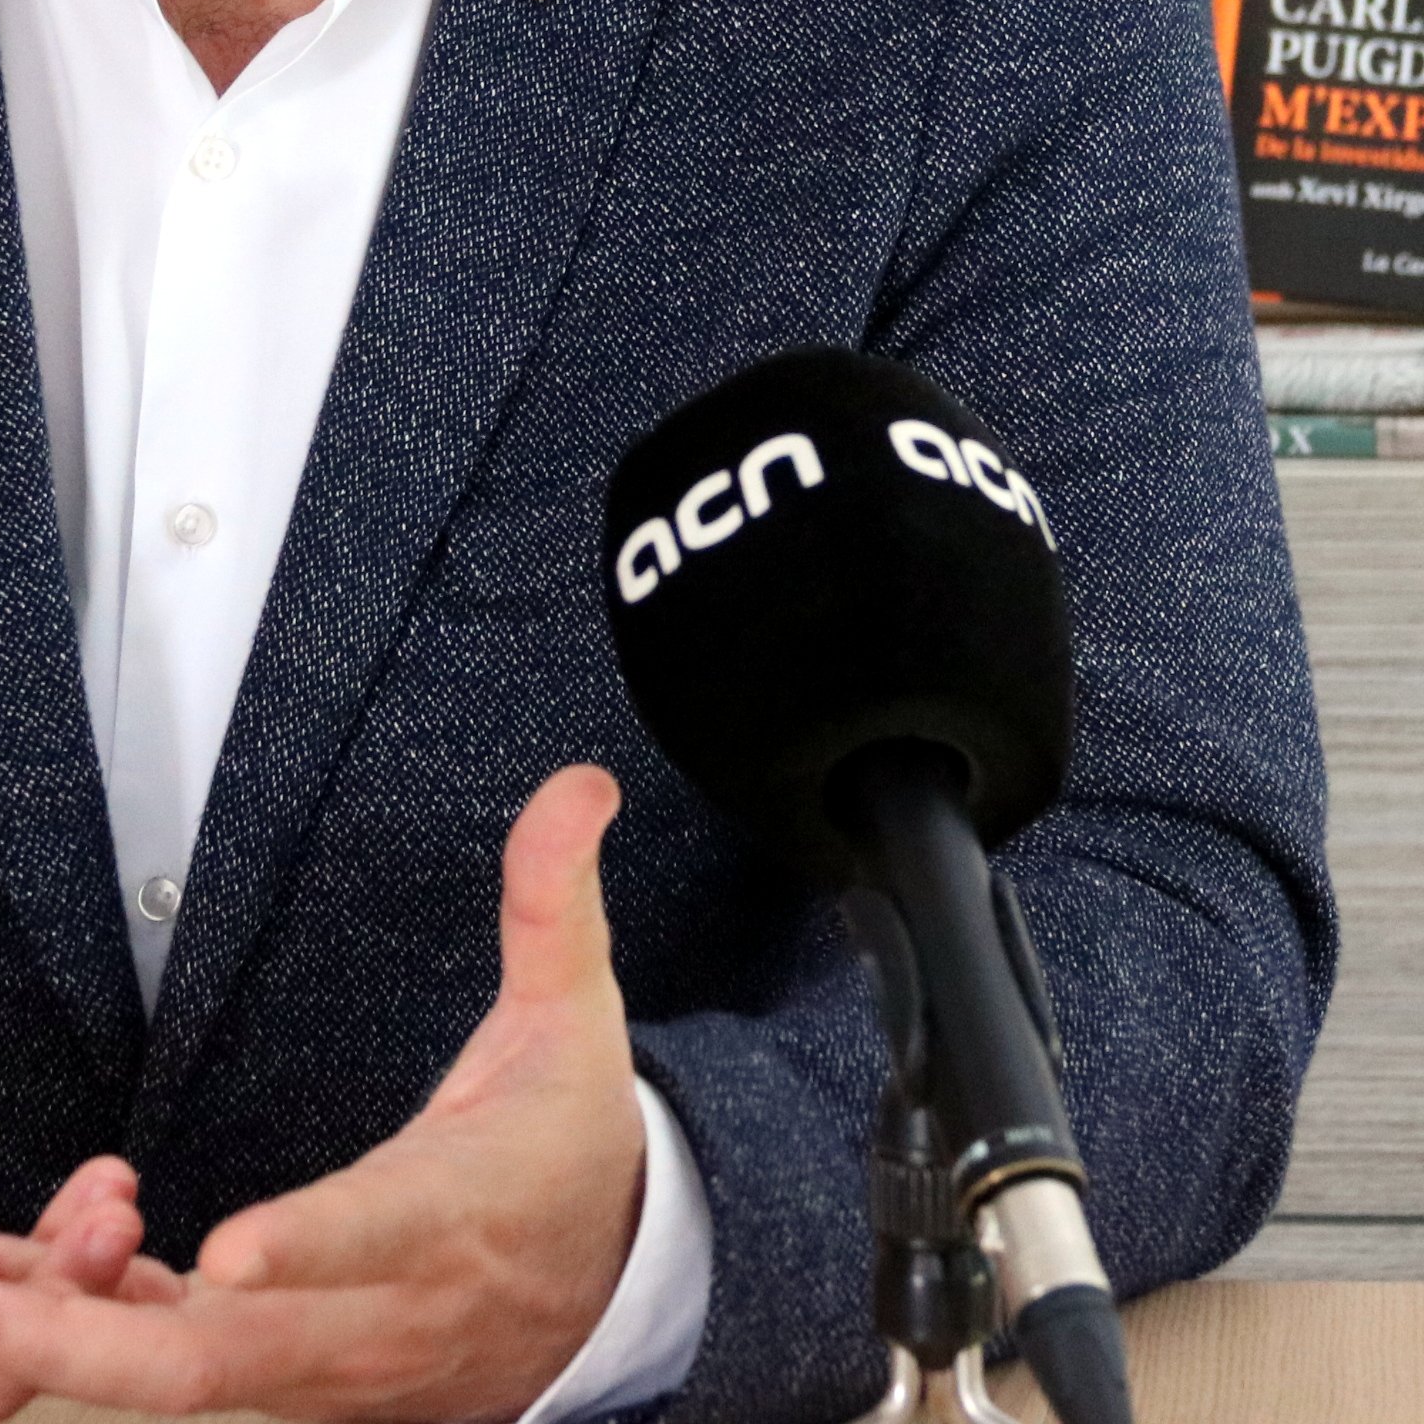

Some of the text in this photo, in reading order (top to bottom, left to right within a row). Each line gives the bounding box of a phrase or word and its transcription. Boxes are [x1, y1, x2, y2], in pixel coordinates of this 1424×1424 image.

[1254, 131, 1289, 161] De
[1292, 135, 1317, 163] la
[1296, 175, 1358, 209] Xevi
[1362, 248, 1390, 274] La
[888, 419, 1058, 552] acn
[616, 432, 825, 604] acn
